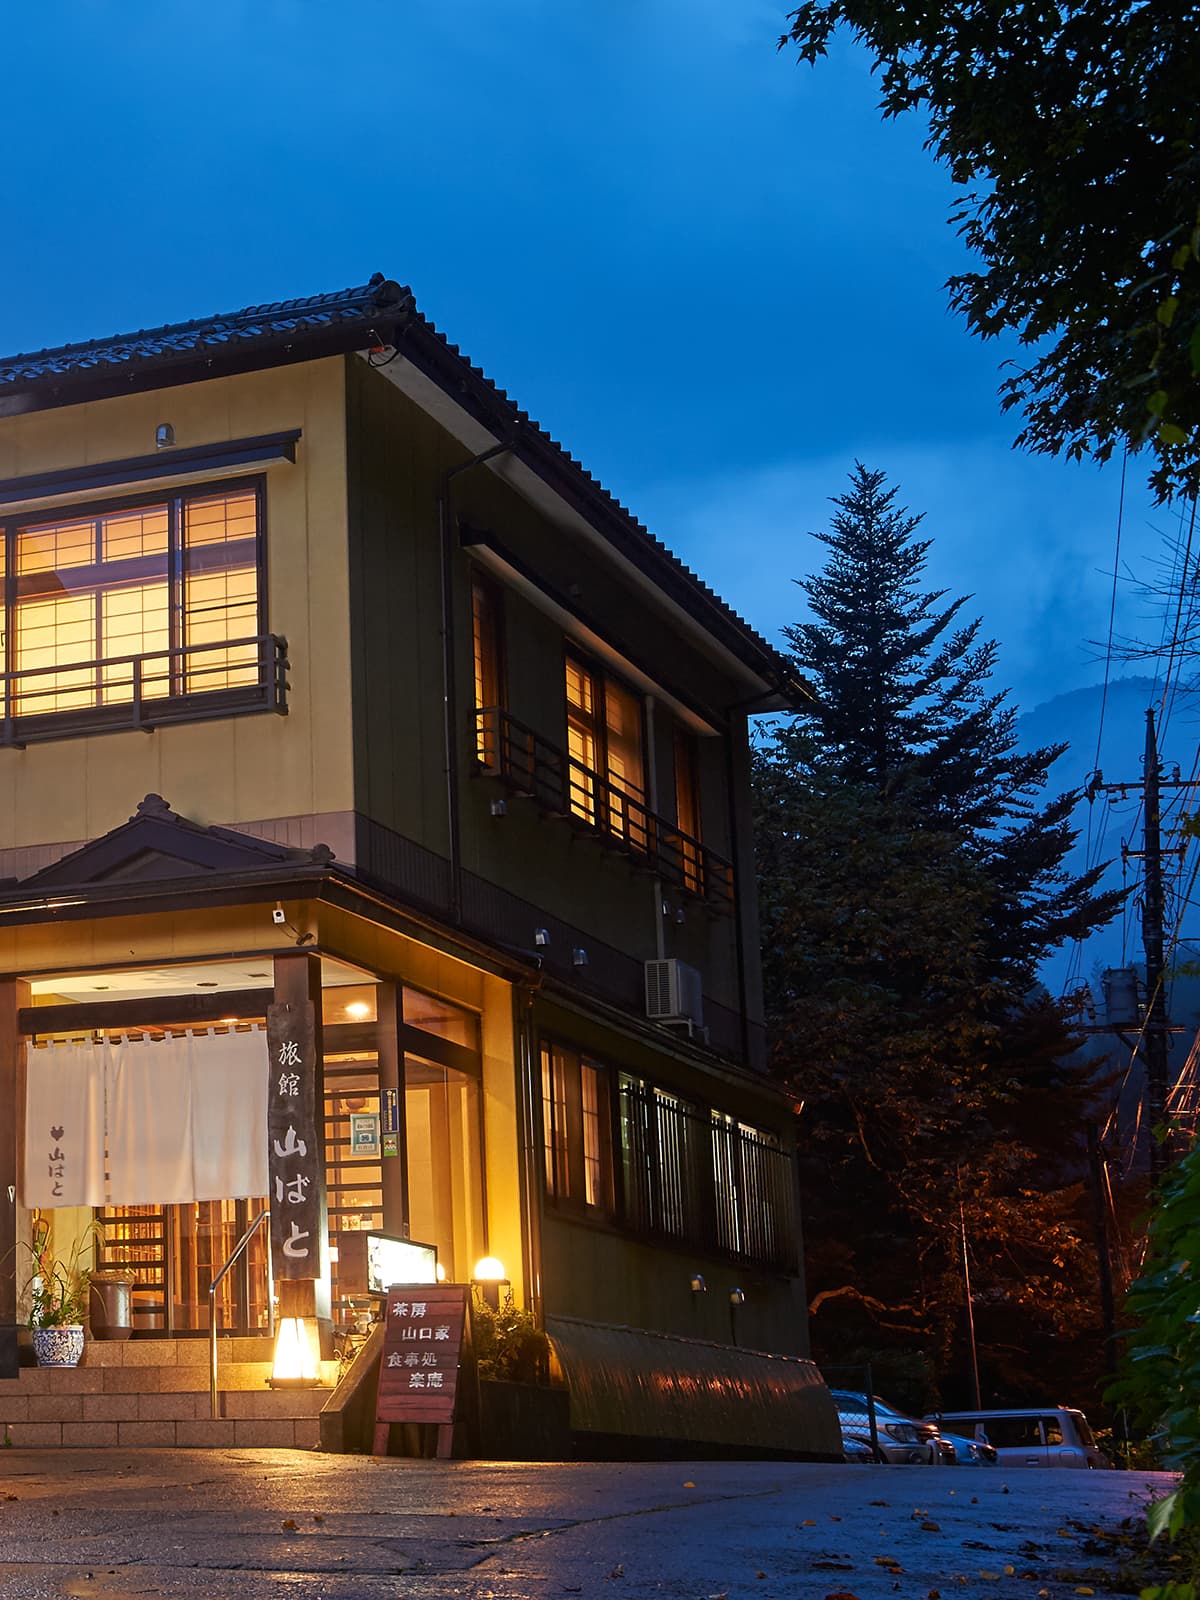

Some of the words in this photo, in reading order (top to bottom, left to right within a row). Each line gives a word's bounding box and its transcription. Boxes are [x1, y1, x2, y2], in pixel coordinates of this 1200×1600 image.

[278, 1040, 302, 1097] 旅館
[273, 1125, 311, 1258] 山ばと
[392, 1302, 427, 1318] 茶房
[402, 1325, 450, 1340] 山口家
[388, 1352, 437, 1367] 食事処
